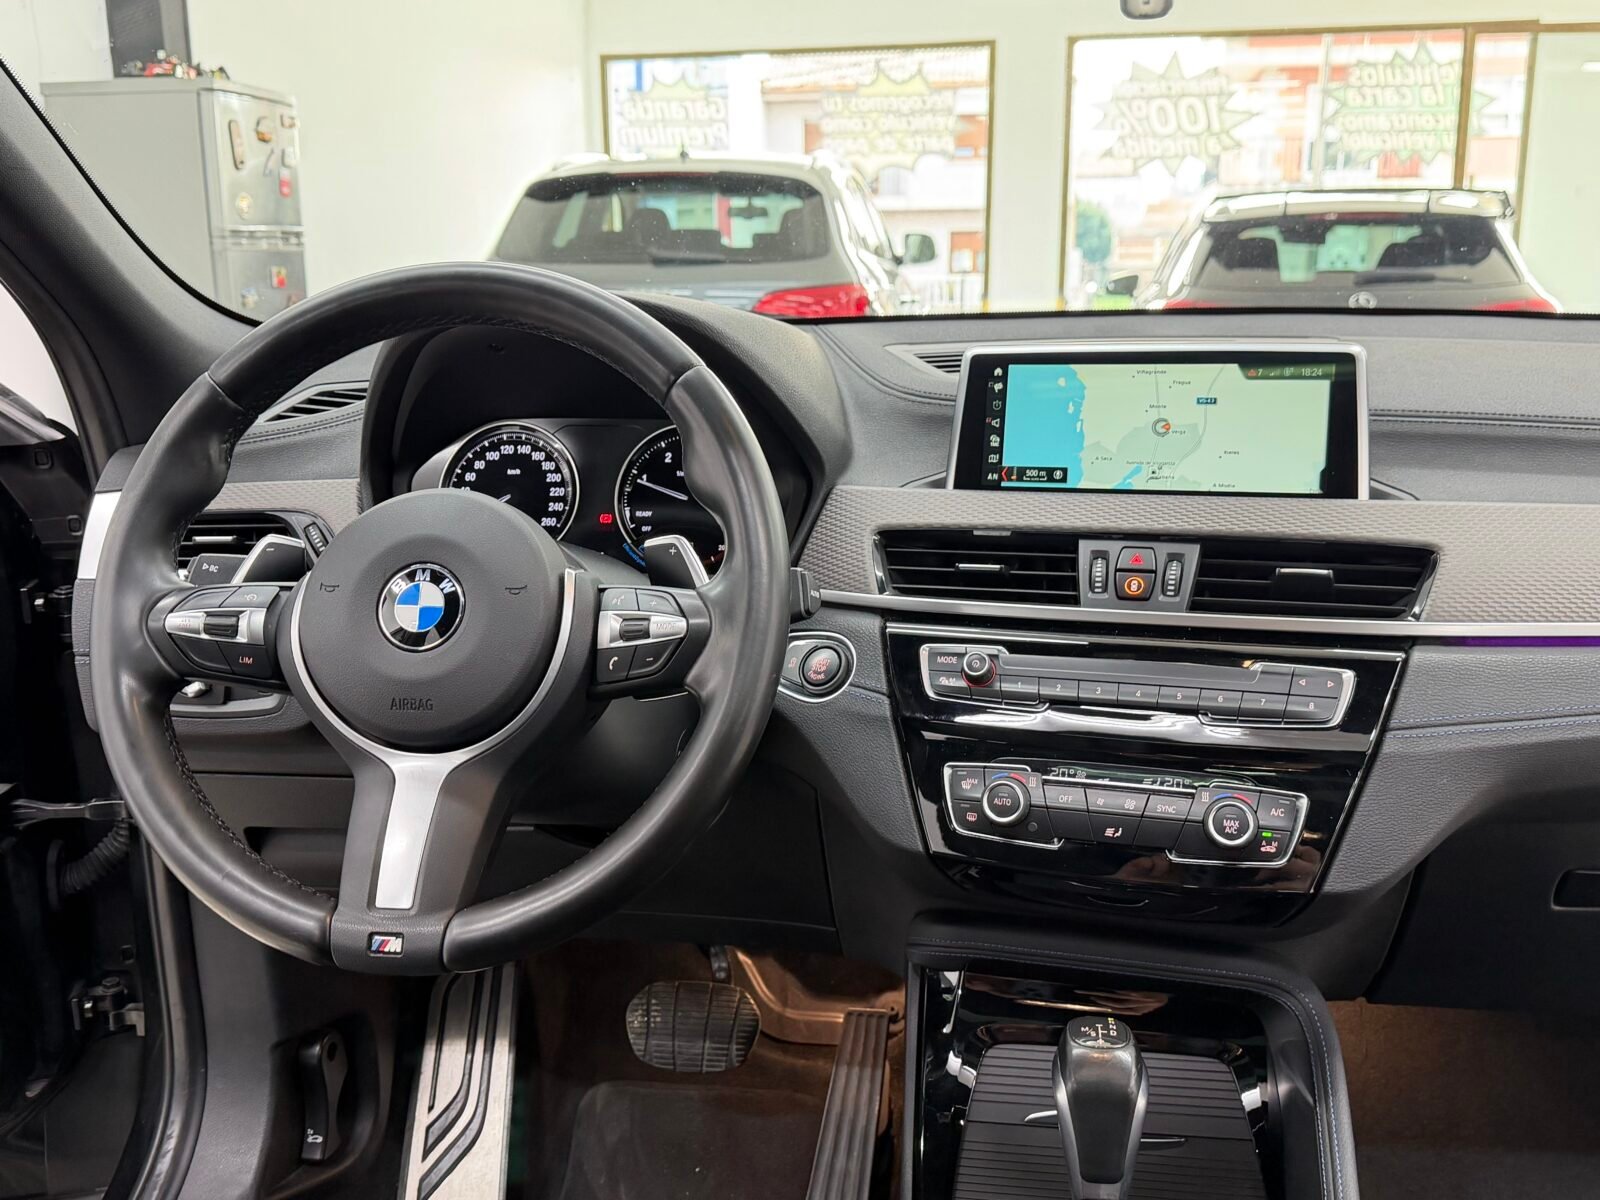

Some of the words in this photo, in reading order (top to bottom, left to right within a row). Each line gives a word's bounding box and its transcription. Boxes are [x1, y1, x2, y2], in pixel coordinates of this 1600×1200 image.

[1301, 368, 1322, 377] 18:24
[500, 445, 515, 454] 120
[517, 445, 531, 454] 140
[485, 451, 500, 460] 100
[531, 452, 545, 461] 160
[664, 452, 672, 463] 2
[474, 461, 485, 469] 80
[541, 461, 555, 470] 180
[465, 472, 476, 481] 60
[546, 473, 561, 482] 200
[1025, 469, 1038, 477] 500
[549, 487, 565, 496] 220
[548, 502, 563, 511] 240
[541, 517, 556, 526] 260
[209, 564, 219, 573] BC
[391, 569, 455, 595] BMW
[239, 656, 253, 664] LIM
[936, 655, 958, 664] MODE
[1176, 692, 1182, 700] 5
[1217, 695, 1223, 703] 6
[390, 698, 433, 711] AIRBAG
[1308, 702, 1315, 710] 8
[966, 778, 978, 786] MAX
[993, 797, 1012, 806] AUTO
[1059, 795, 1073, 803] OFF
[1156, 804, 1176, 814] SYNC
[1270, 807, 1285, 817] A/C
[1223, 819, 1239, 828] MAX
[1225, 826, 1237, 834] A/C
